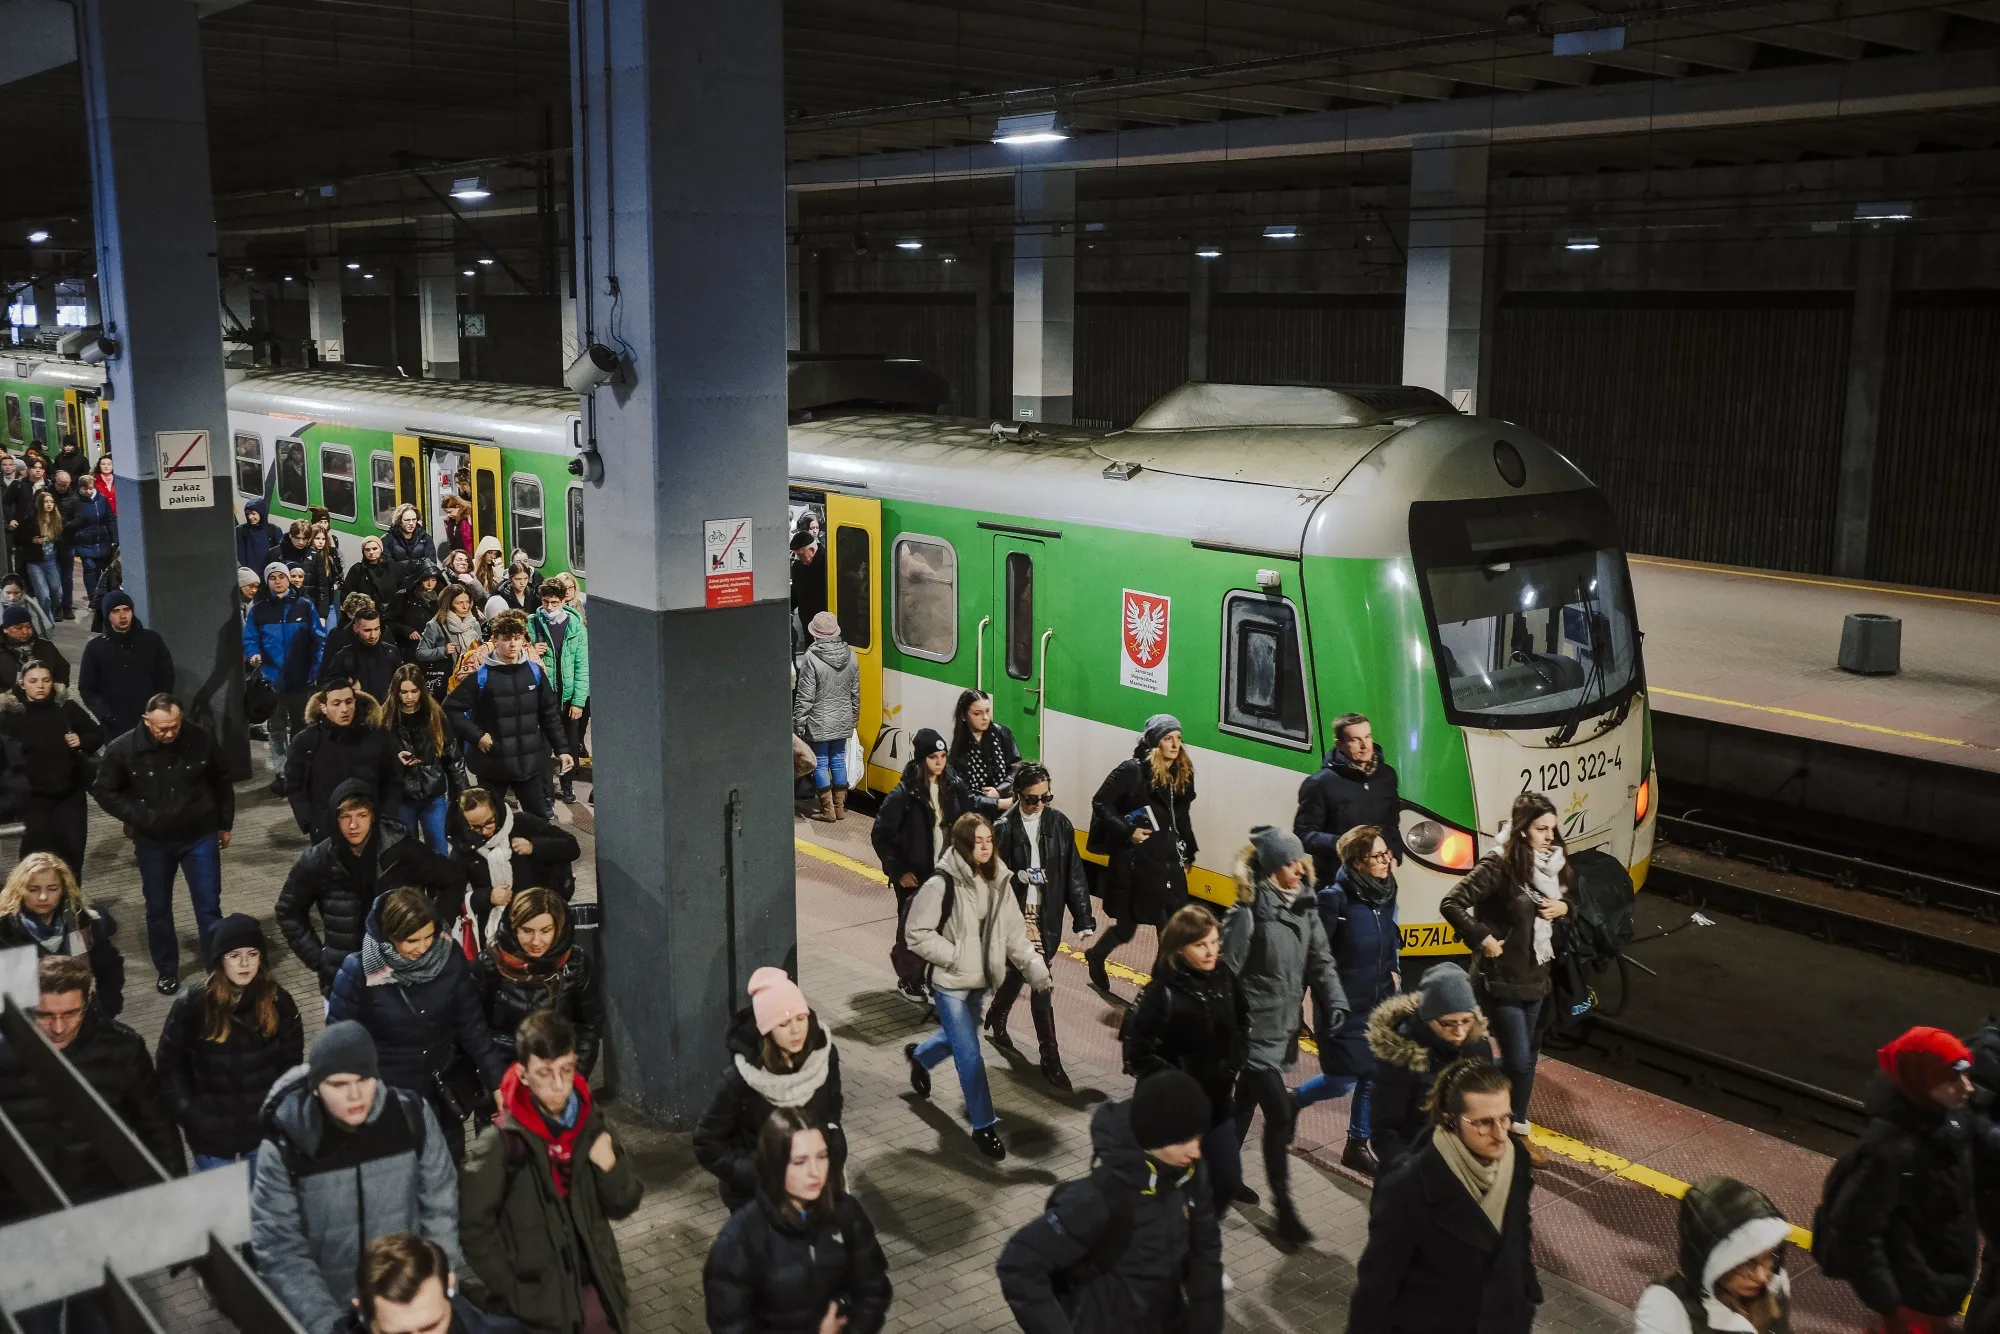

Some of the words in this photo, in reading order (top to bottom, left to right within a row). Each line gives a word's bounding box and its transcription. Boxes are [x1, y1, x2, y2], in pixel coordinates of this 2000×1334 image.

[172, 483, 200, 492] zakaz
[169, 494, 205, 505] palenia
[1520, 768, 1532, 794] 2
[1540, 760, 1570, 792] 120
[1578, 745, 1622, 782] 322-4
